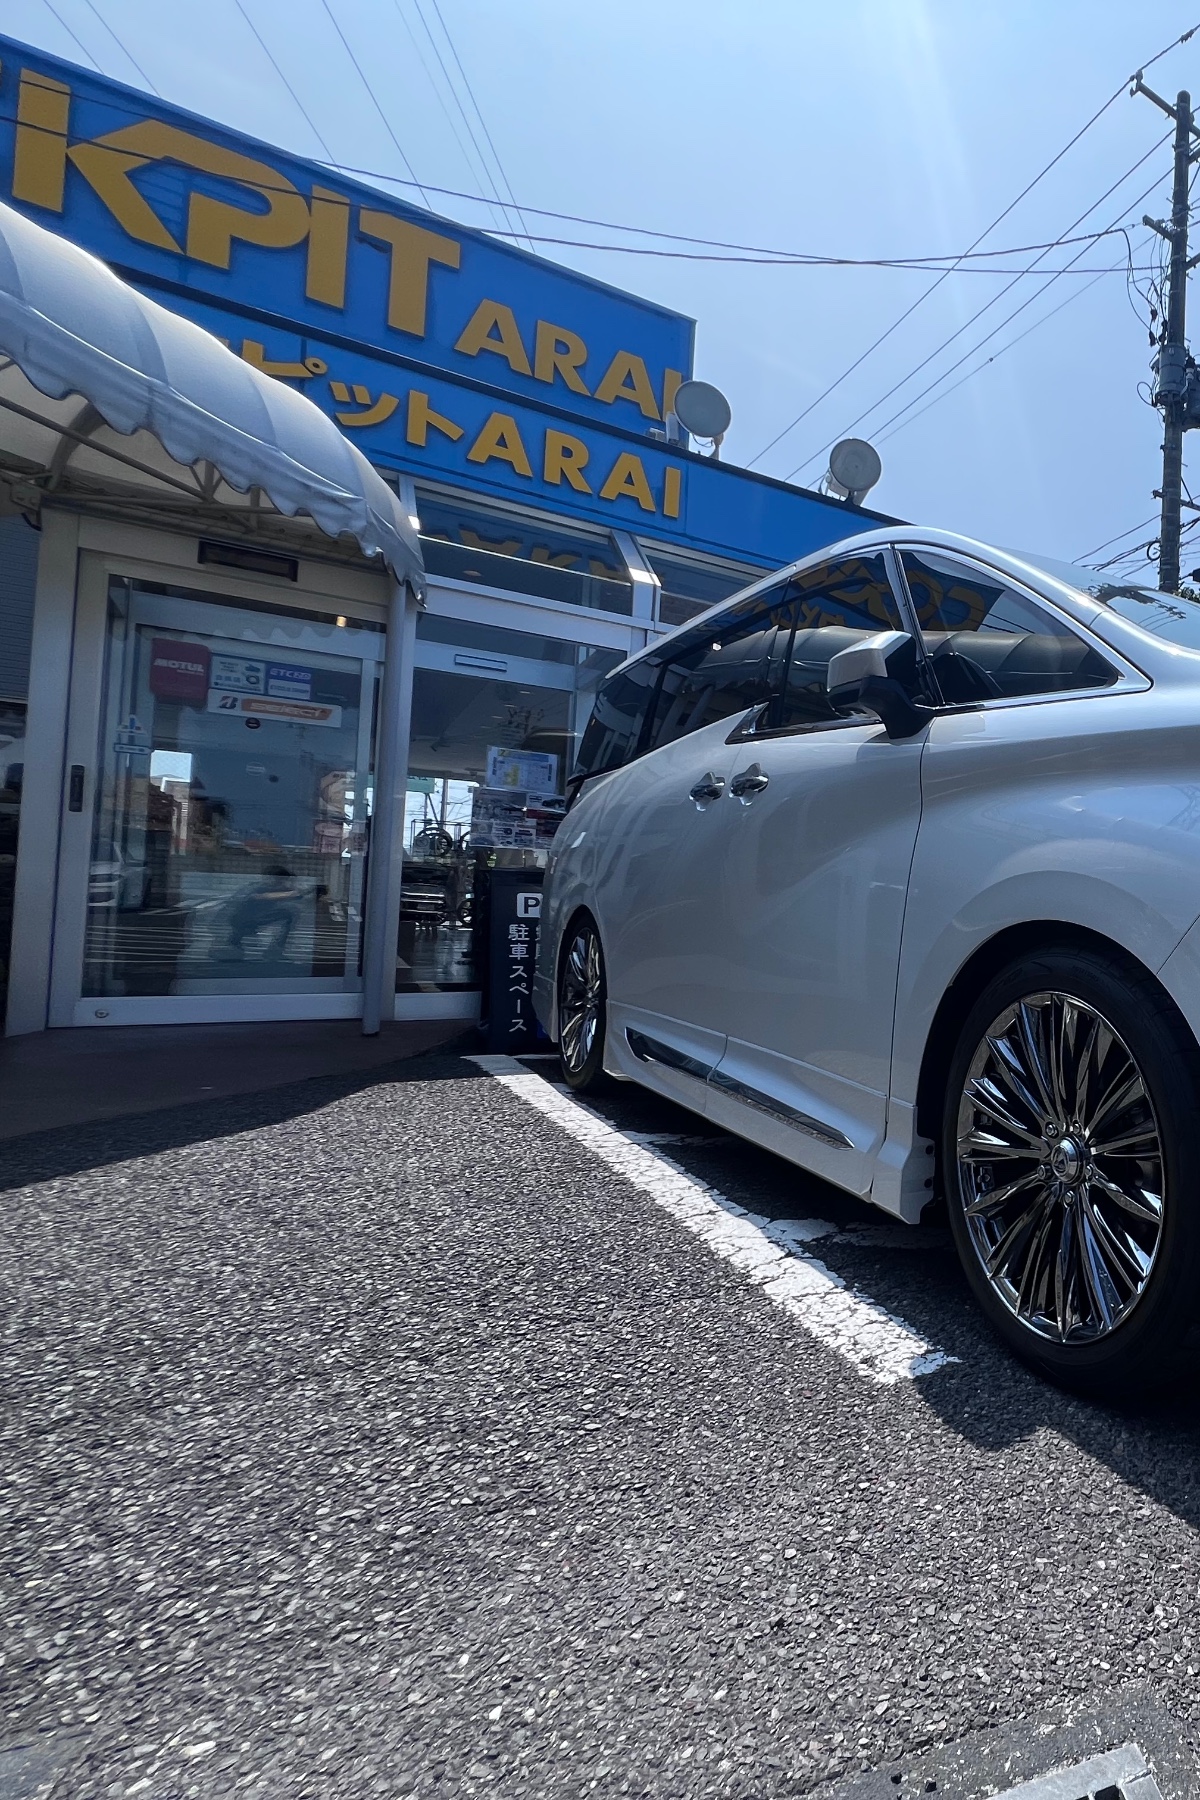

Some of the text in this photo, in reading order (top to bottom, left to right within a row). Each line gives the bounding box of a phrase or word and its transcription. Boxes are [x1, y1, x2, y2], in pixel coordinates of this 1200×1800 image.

[0, 62, 683, 423] KPIT ARAI
[153, 657, 205, 672] MOTUL
[523, 896, 541, 915] P
[508, 923, 531, 1033] 駐車スペース
